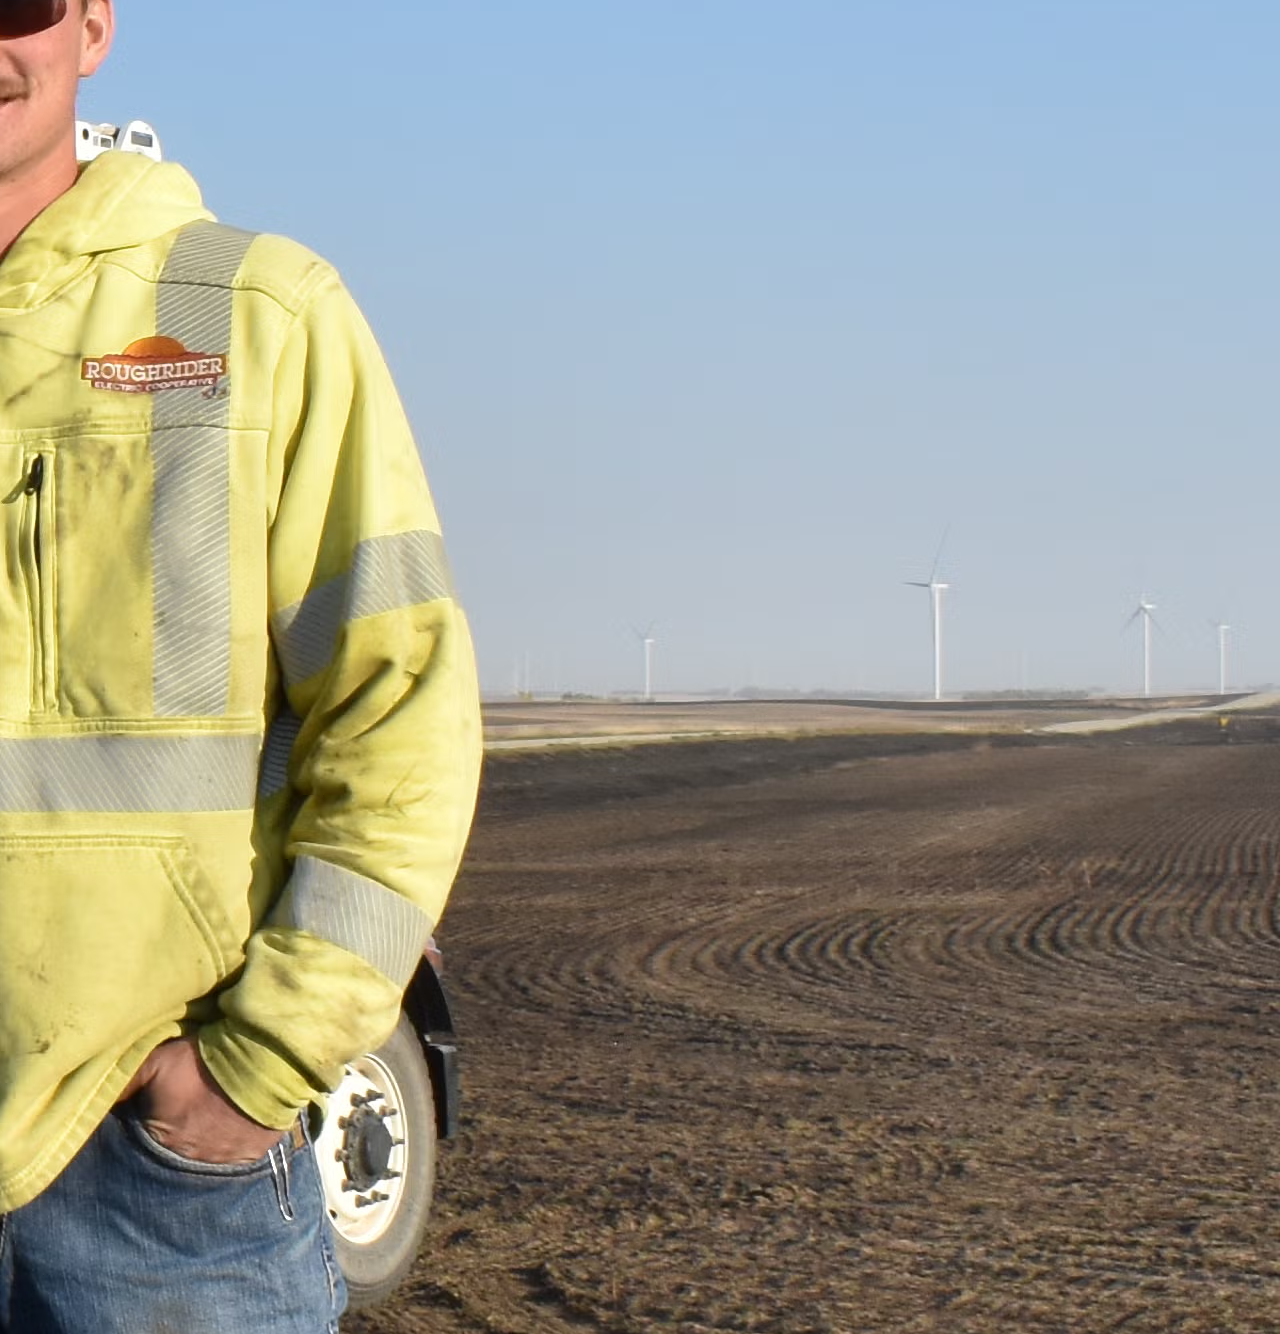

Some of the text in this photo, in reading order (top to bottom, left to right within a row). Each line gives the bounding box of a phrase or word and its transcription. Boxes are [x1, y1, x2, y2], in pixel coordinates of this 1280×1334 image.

[85, 357, 223, 382] ROUGHRIDER
[94, 377, 214, 392] ELECTRIC COOPERATIVE
